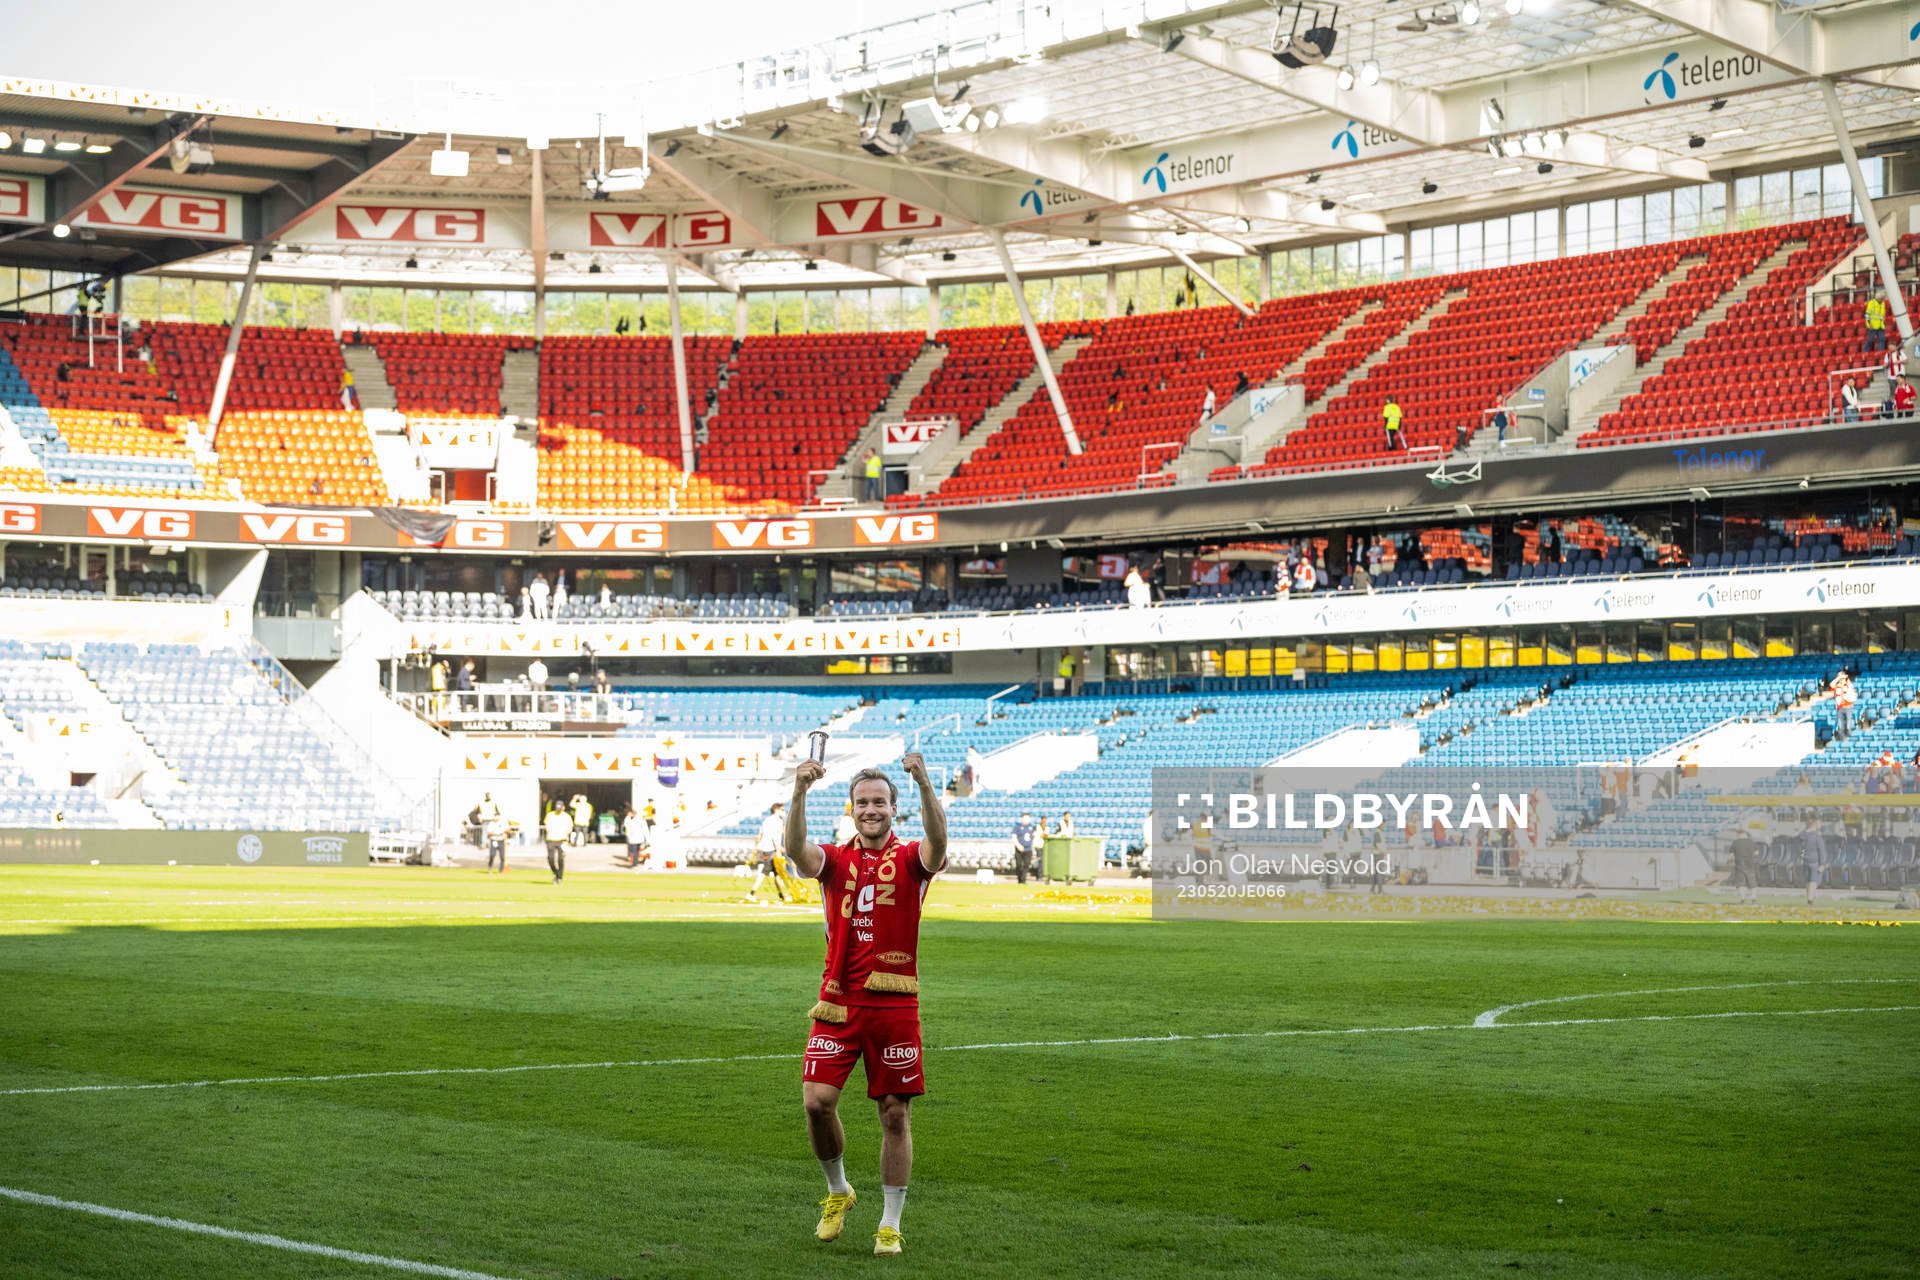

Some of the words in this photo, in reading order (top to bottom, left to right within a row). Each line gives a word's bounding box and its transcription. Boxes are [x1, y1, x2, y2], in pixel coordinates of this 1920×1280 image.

[1170, 153, 1234, 183] telenor
[97, 191, 221, 232] VG
[339, 207, 479, 242] VG
[818, 198, 939, 234] VG
[594, 210, 726, 246] VG
[889, 425, 945, 441] VG
[0, 505, 36, 532] G
[91, 508, 191, 537] VG
[242, 514, 346, 543] VG
[856, 515, 935, 543] VG
[560, 522, 663, 549] VG
[715, 520, 811, 547] VG
[1716, 588, 1763, 603] telenor
[1827, 580, 1876, 597] telenor
[807, 1037, 843, 1053] LERØY
[884, 1047, 919, 1059] LERØY
[804, 1060, 817, 1076] 11
